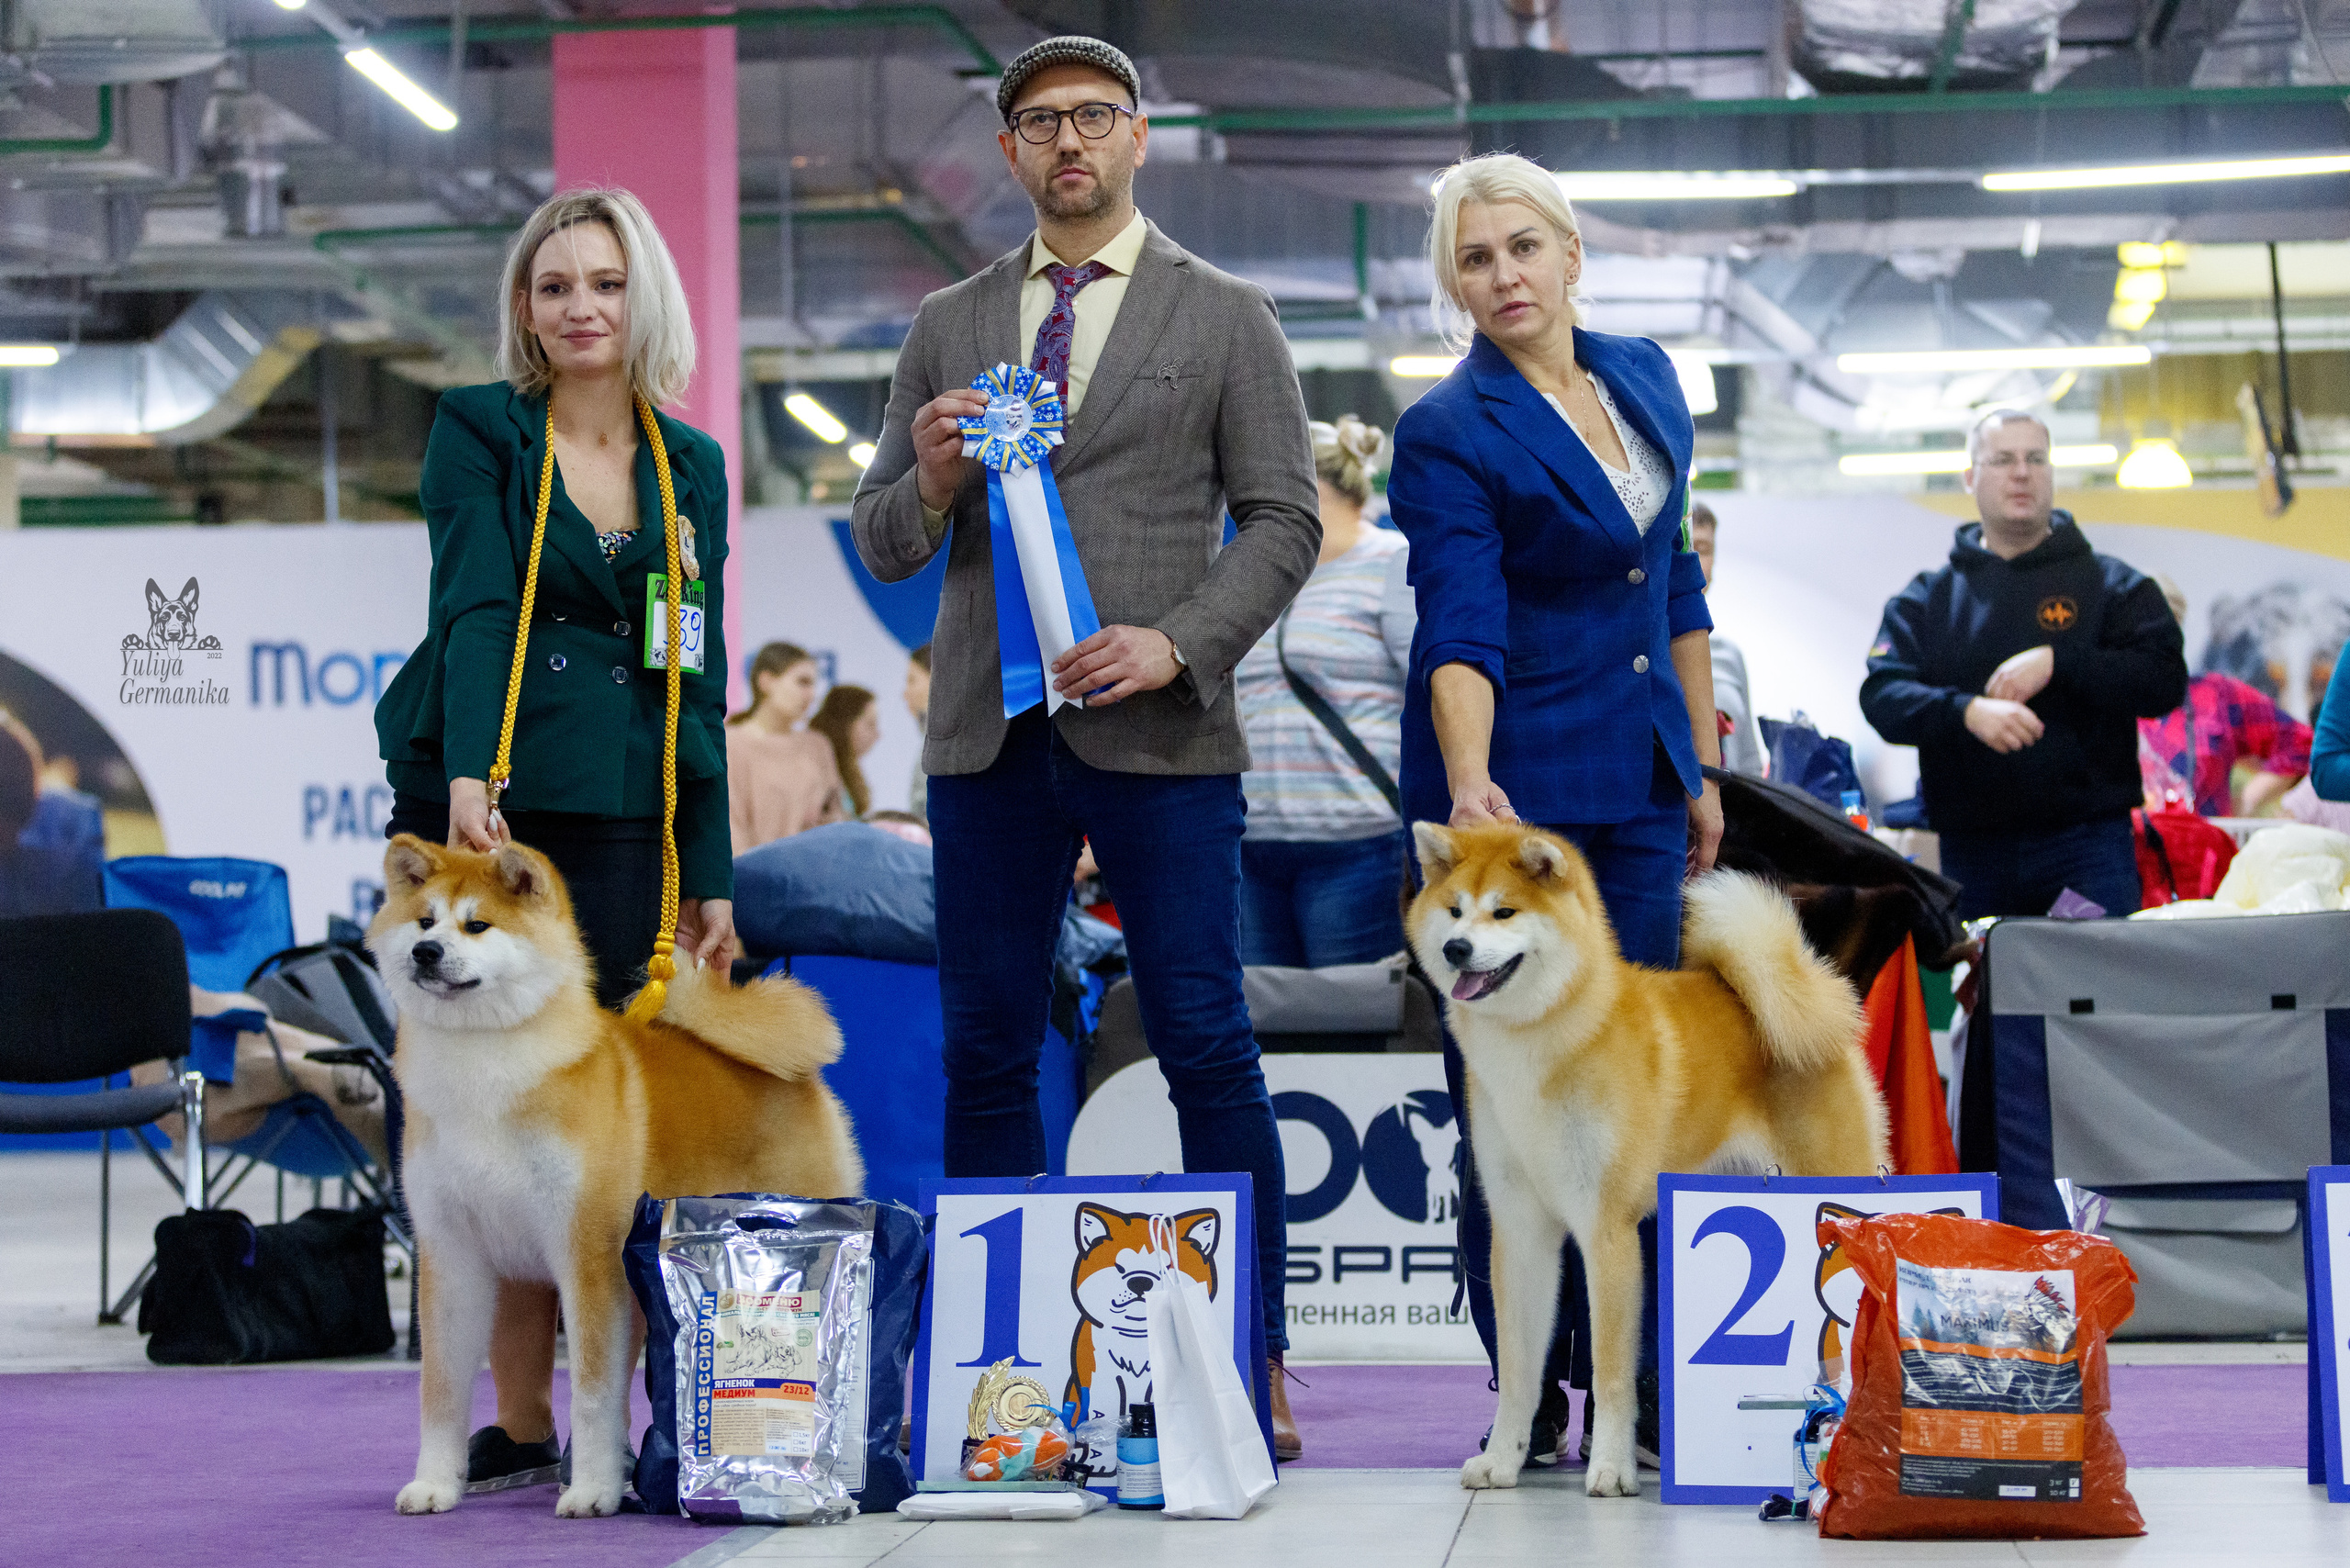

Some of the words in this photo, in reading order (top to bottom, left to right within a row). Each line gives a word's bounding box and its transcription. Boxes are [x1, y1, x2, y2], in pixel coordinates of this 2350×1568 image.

[956, 1206, 1042, 1368] 1
[1687, 1204, 1796, 1367] 2
[698, 1295, 715, 1456] ПРОФЕССИОНАЛ
[713, 1379, 755, 1389] ЯГНЕНОК
[713, 1389, 755, 1399] МЕДИУМ
[783, 1384, 810, 1395] 23/12
